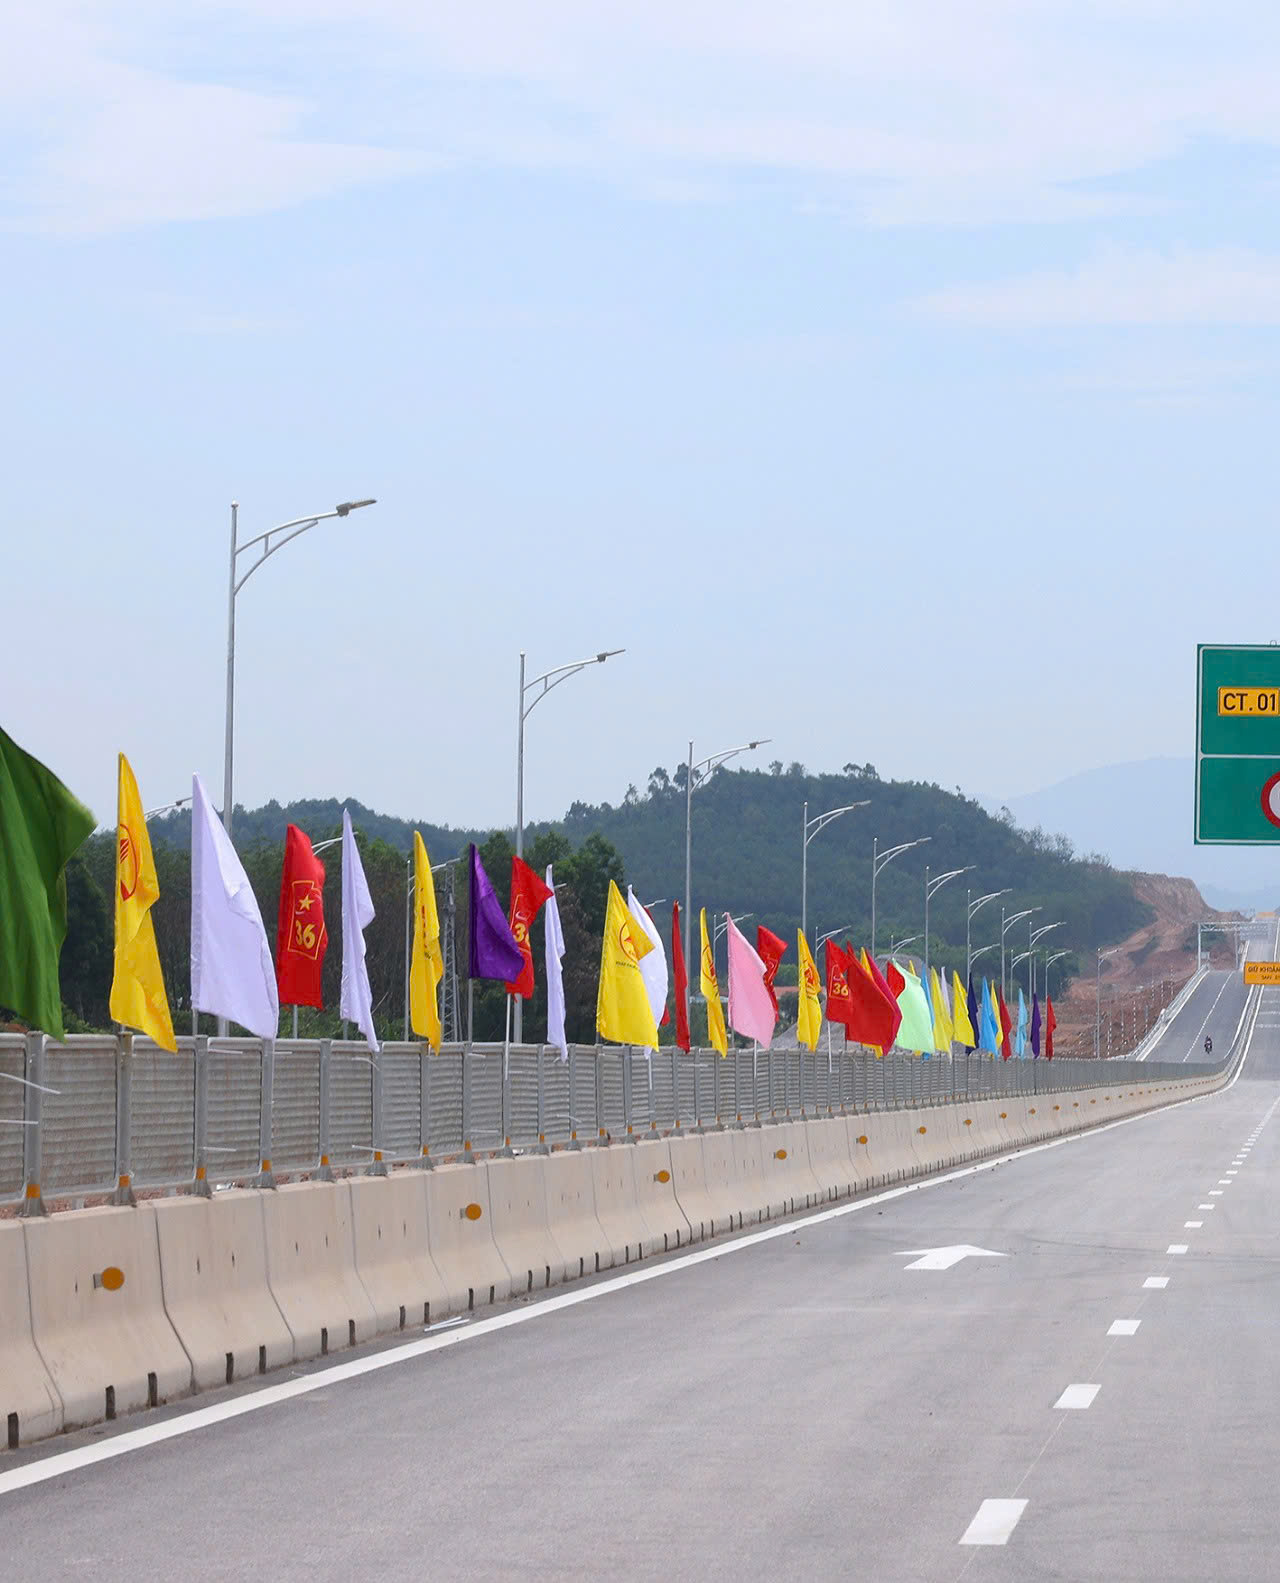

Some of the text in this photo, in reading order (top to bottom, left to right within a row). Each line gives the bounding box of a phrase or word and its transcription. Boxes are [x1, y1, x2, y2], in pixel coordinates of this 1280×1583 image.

[1223, 692, 1276, 712] CT.01
[295, 919, 316, 949] 36
[831, 982, 849, 996] 36
